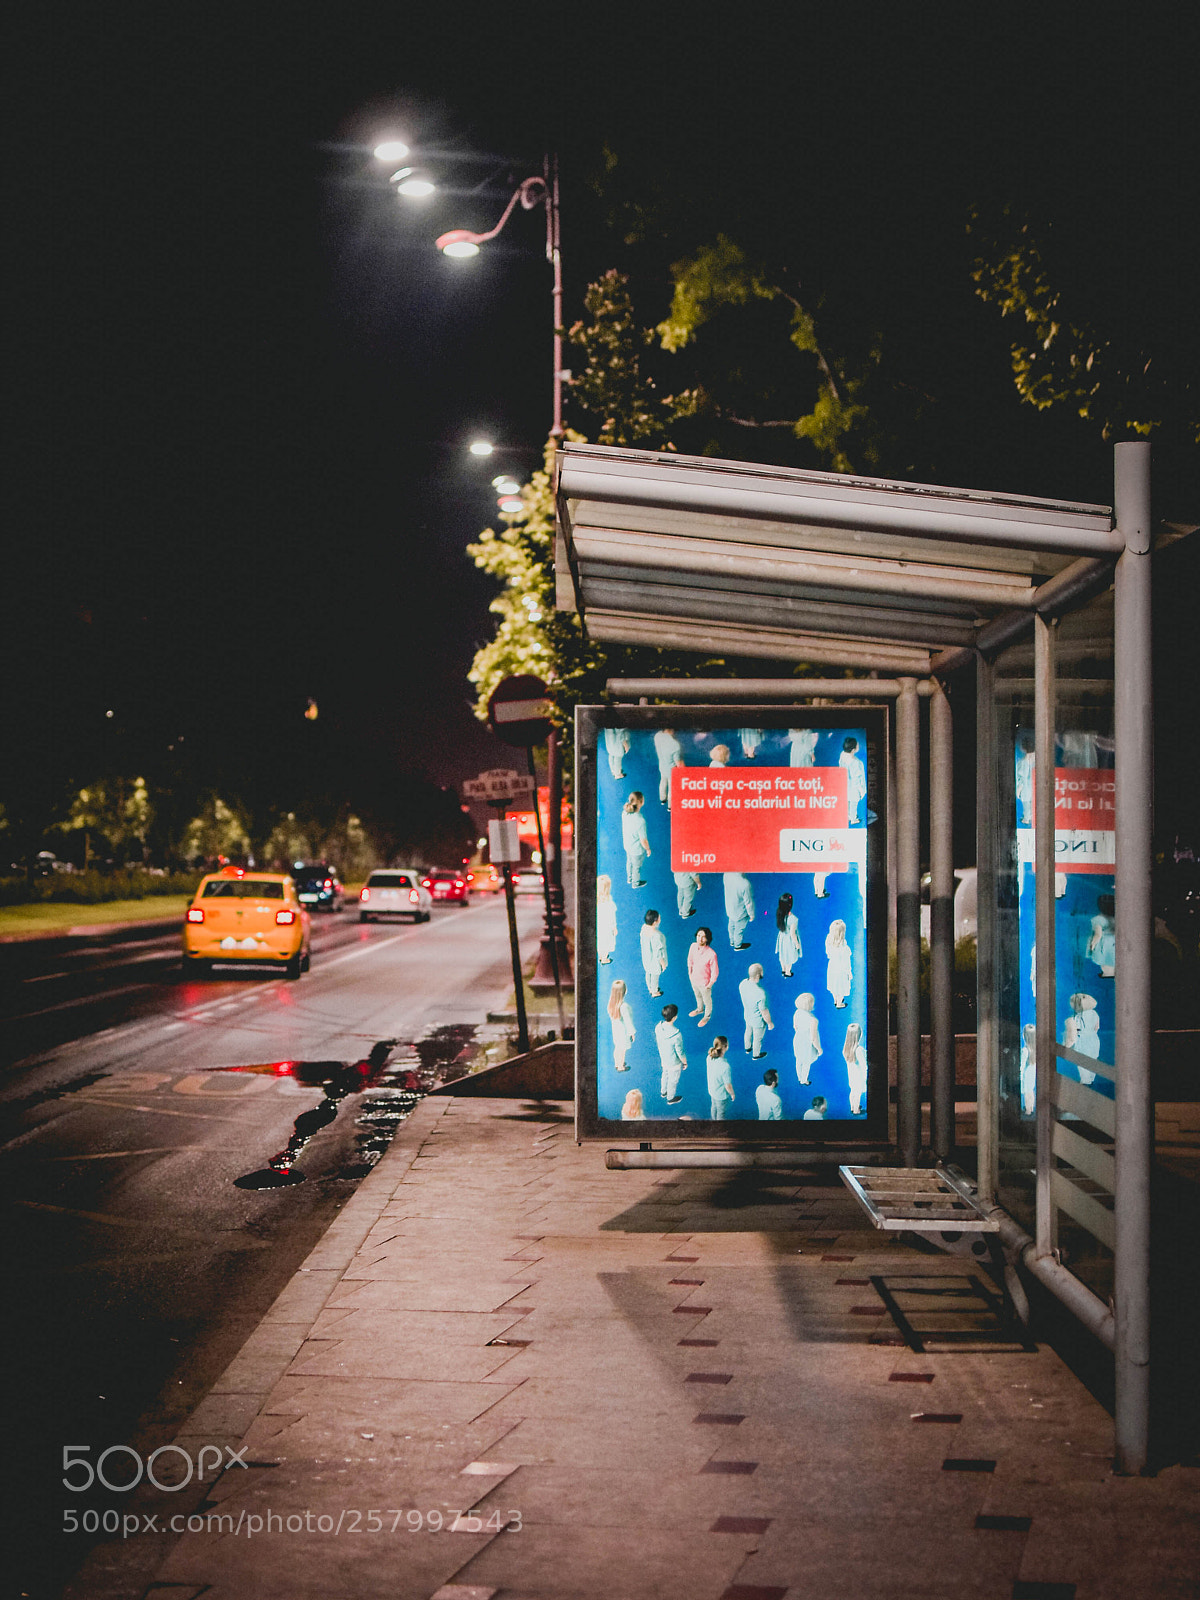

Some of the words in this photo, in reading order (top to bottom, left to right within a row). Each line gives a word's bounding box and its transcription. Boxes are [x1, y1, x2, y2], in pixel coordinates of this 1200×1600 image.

[681, 777, 707, 790] Faci
[710, 780, 733, 794] așa
[774, 777, 795, 790] fac
[681, 798, 704, 808] sau
[707, 796, 722, 808] vii
[725, 798, 741, 808] cu
[743, 796, 790, 808] salariul
[794, 796, 806, 808] la
[809, 796, 838, 808] ING?
[791, 839, 824, 851] ING
[681, 851, 716, 866] ing.ro
